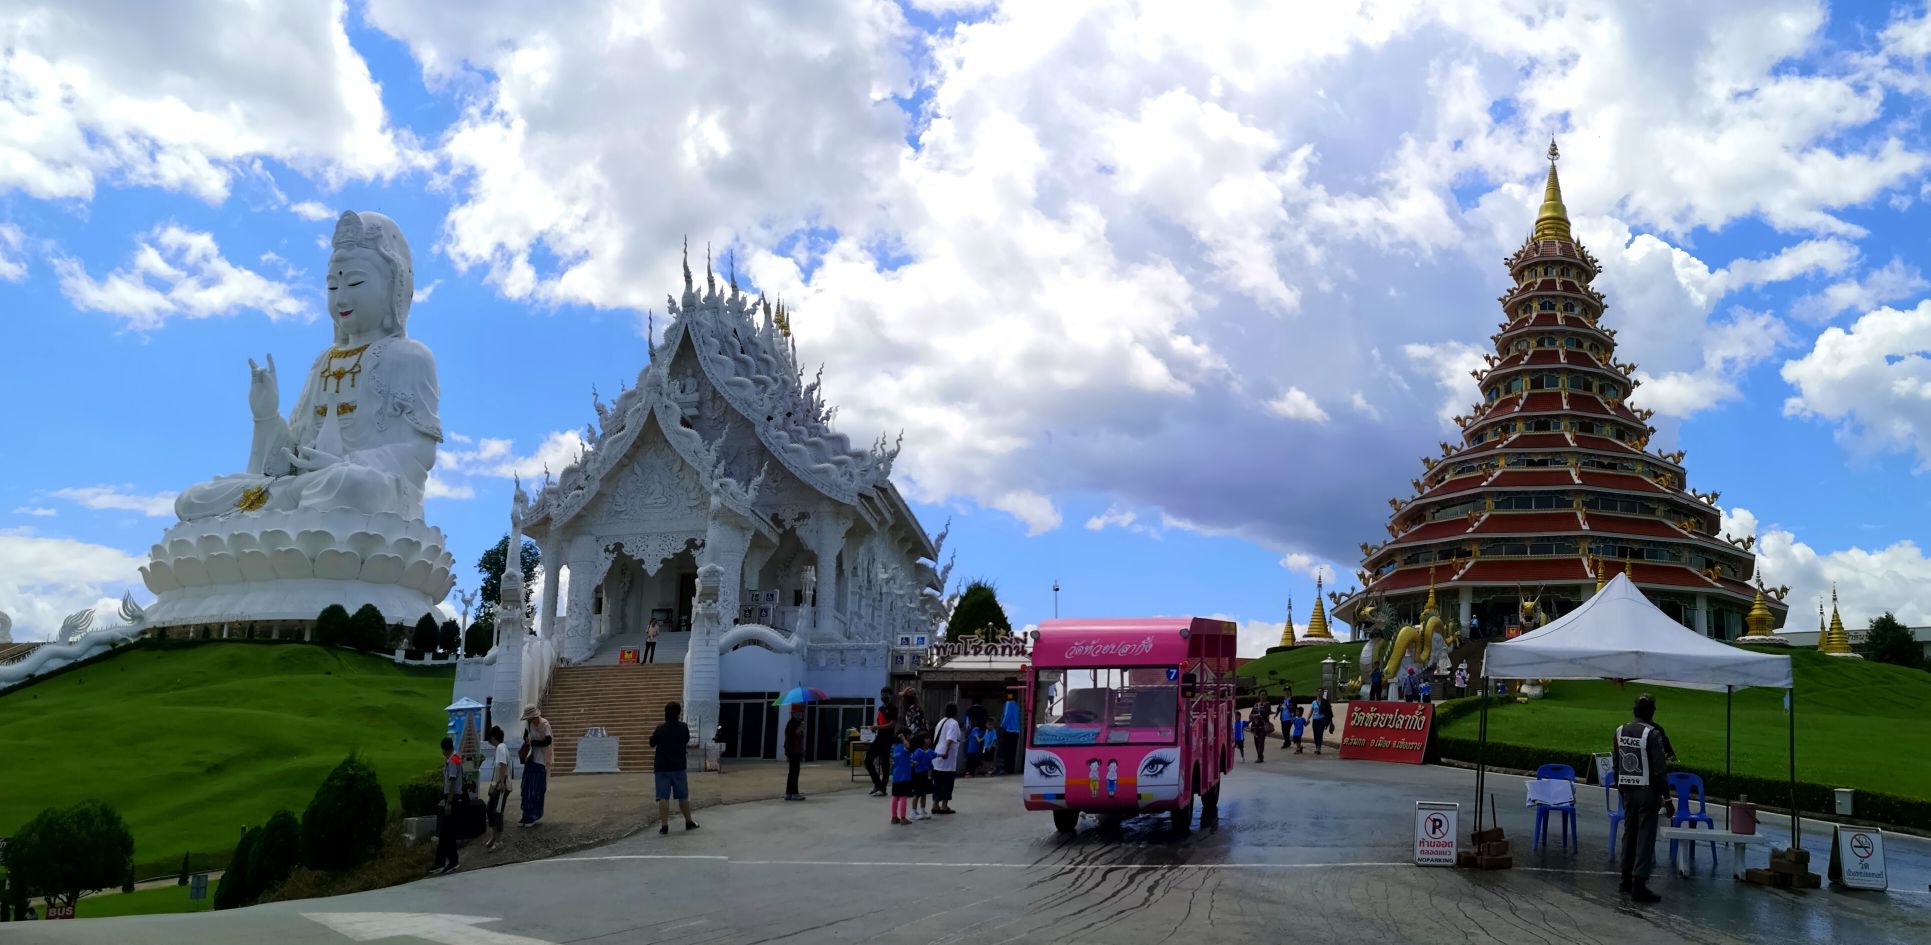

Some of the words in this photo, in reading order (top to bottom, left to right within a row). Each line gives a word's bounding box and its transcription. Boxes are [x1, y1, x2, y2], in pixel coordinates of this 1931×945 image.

[1065, 636, 1154, 658] วัดห้วยปลากั้ง
[1169, 669, 1177, 680] 7
[1351, 704, 1426, 730] วัดห้วยปลากั้ง
[1620, 737, 1641, 747] POLICE
[1419, 838, 1454, 848] ห้ามจอด
[48, 906, 73, 917] BUS
